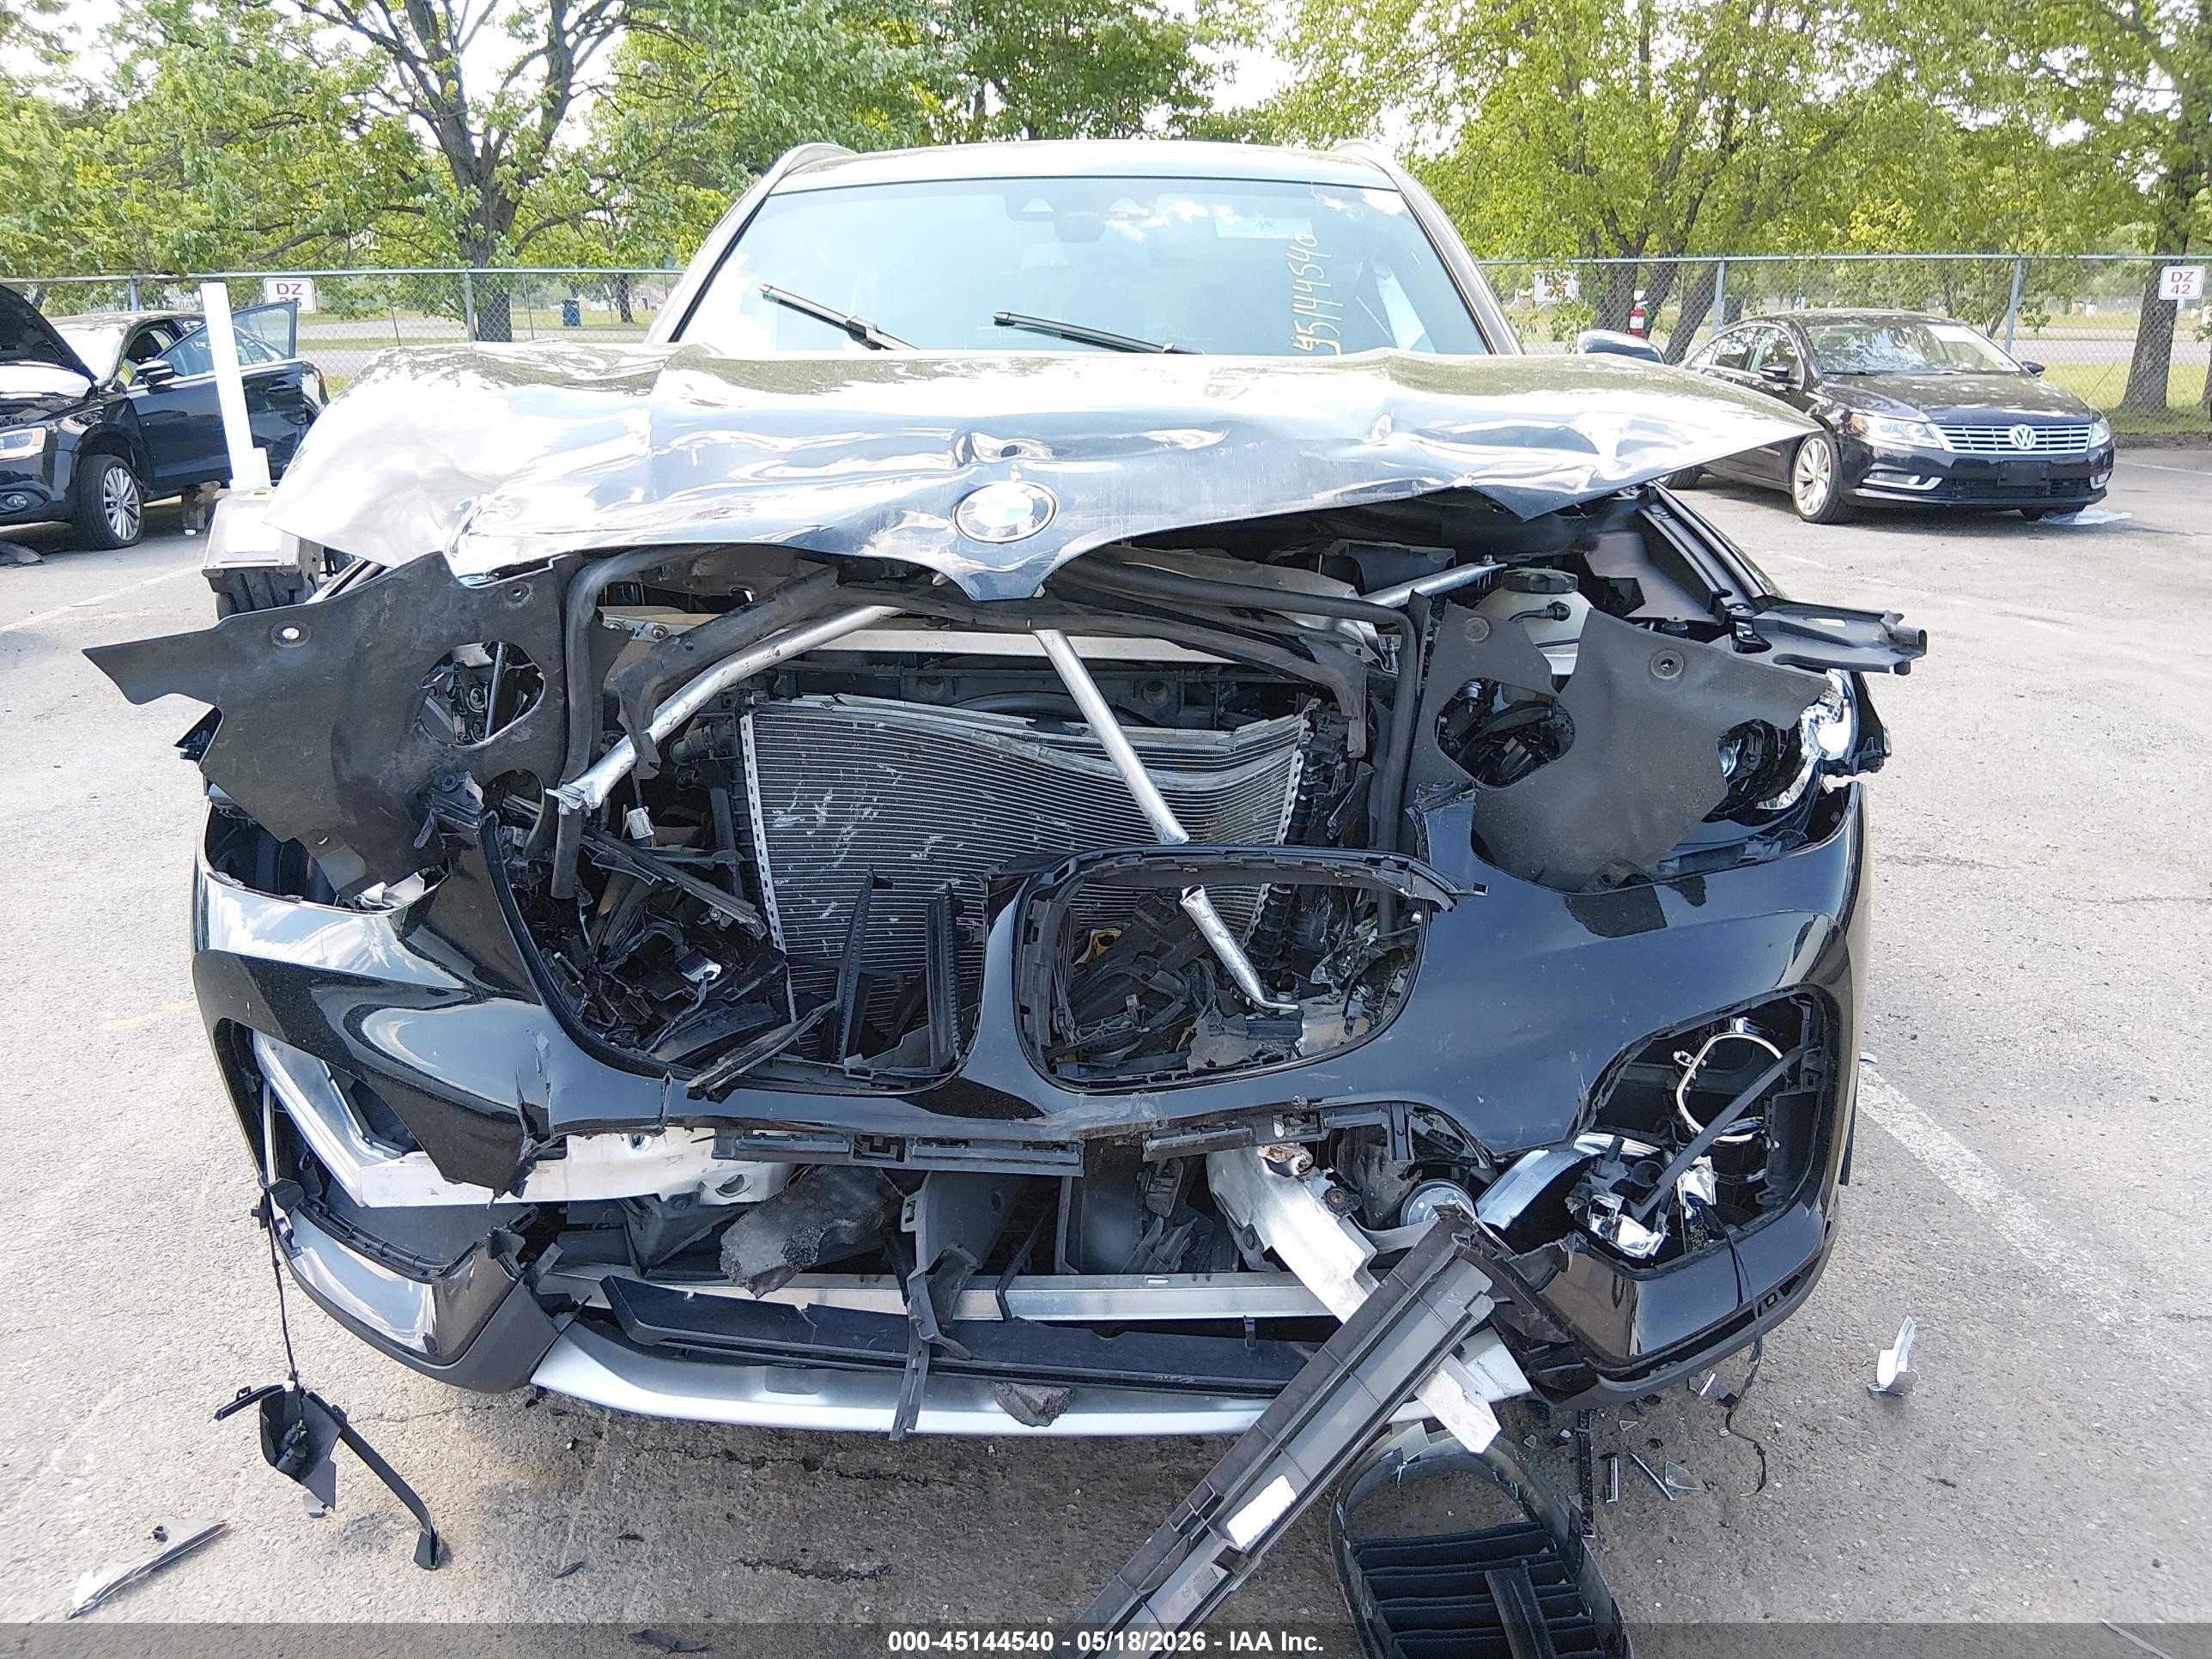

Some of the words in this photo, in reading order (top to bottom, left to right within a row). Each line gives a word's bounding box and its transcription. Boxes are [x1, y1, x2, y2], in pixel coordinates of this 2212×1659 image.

[2171, 270, 2195, 283] DZ
[276, 283, 303, 295] DZ
[2170, 283, 2191, 295] 42
